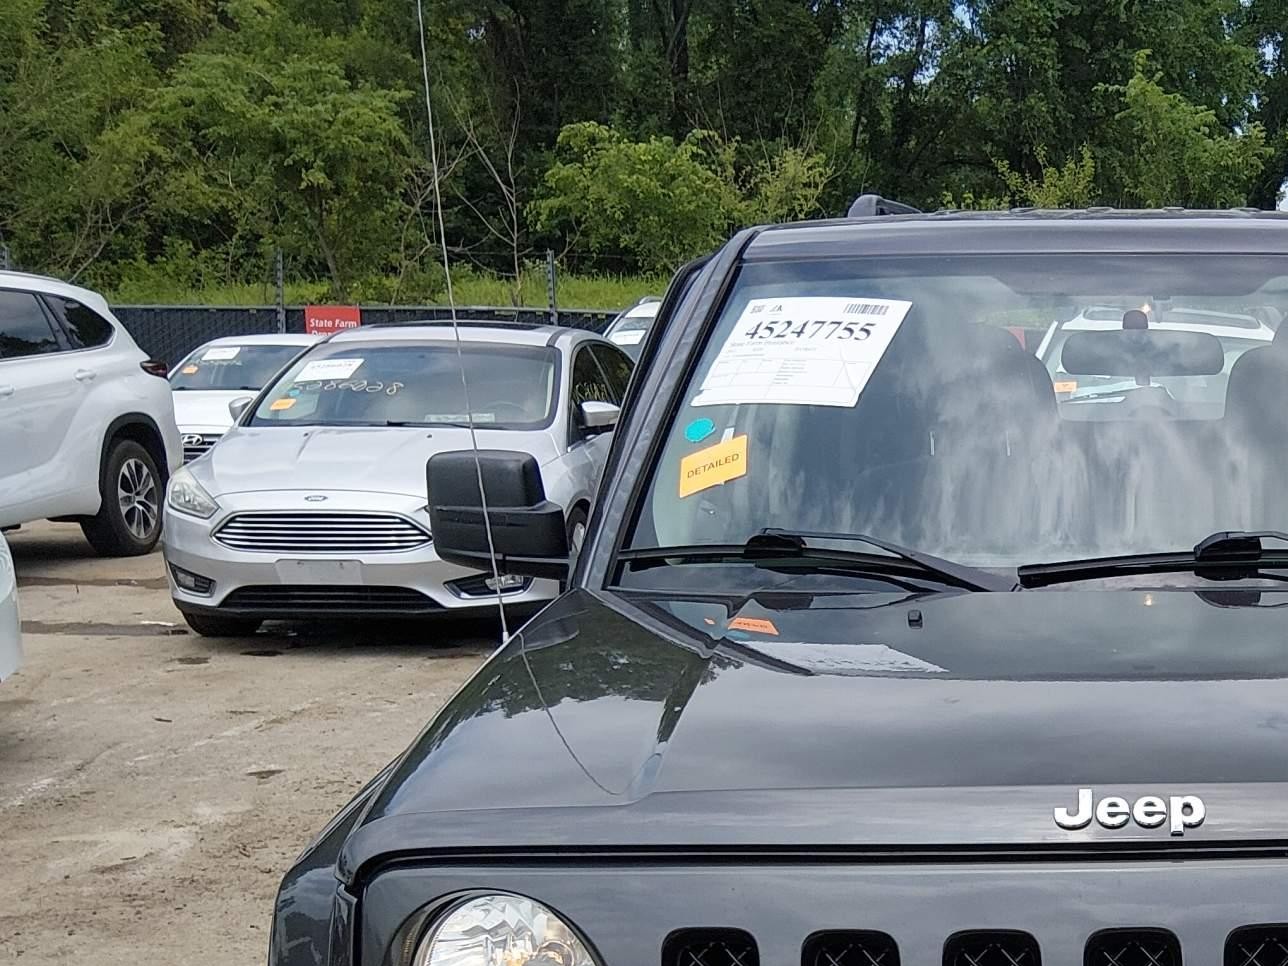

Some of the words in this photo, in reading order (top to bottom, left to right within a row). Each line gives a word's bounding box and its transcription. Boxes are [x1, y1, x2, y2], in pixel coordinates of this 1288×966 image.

[310, 318, 333, 328] State
[335, 318, 357, 328] Farm
[745, 319, 876, 341] 45247755
[687, 453, 740, 479] DETAILED
[1053, 788, 1206, 837] Jeep
